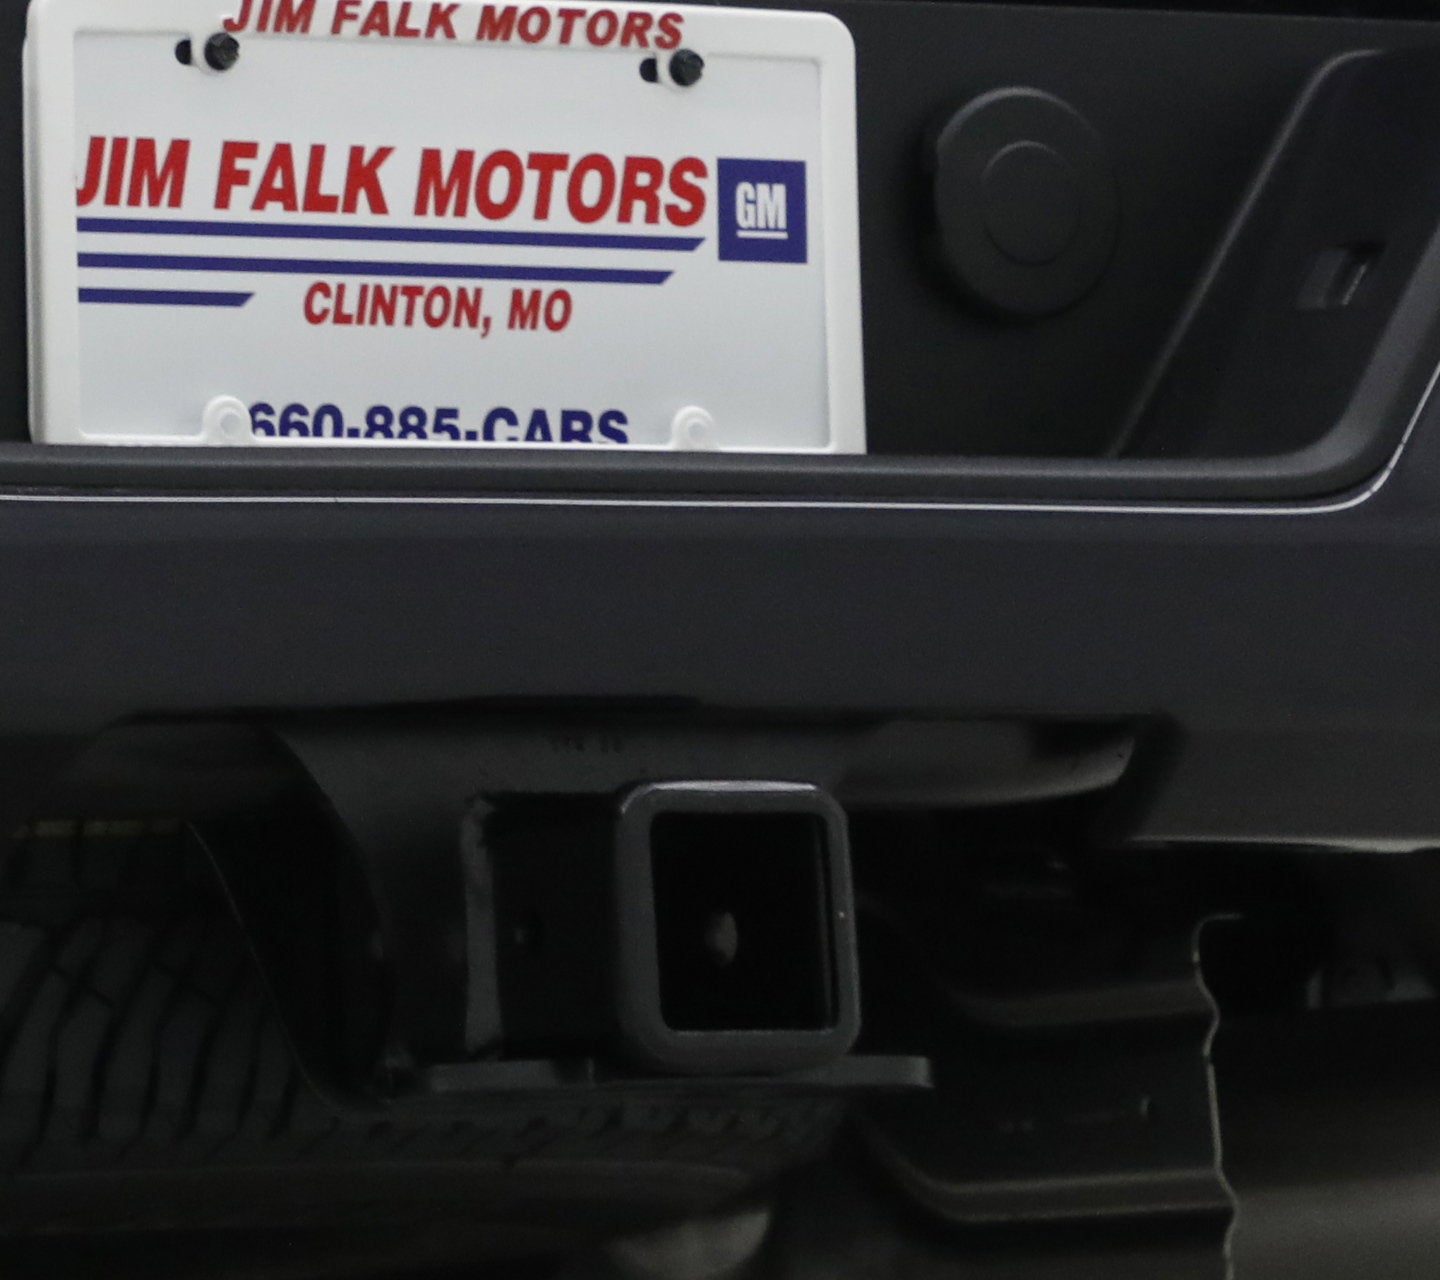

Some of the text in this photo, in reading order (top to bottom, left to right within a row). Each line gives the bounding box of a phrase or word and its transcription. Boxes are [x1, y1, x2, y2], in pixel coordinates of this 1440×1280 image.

[476, 4, 685, 50] MOTORS
[75, 136, 708, 228] JIM FALK MOTORS
[735, 181, 789, 230] GM
[303, 281, 573, 339] CLINTON, MO
